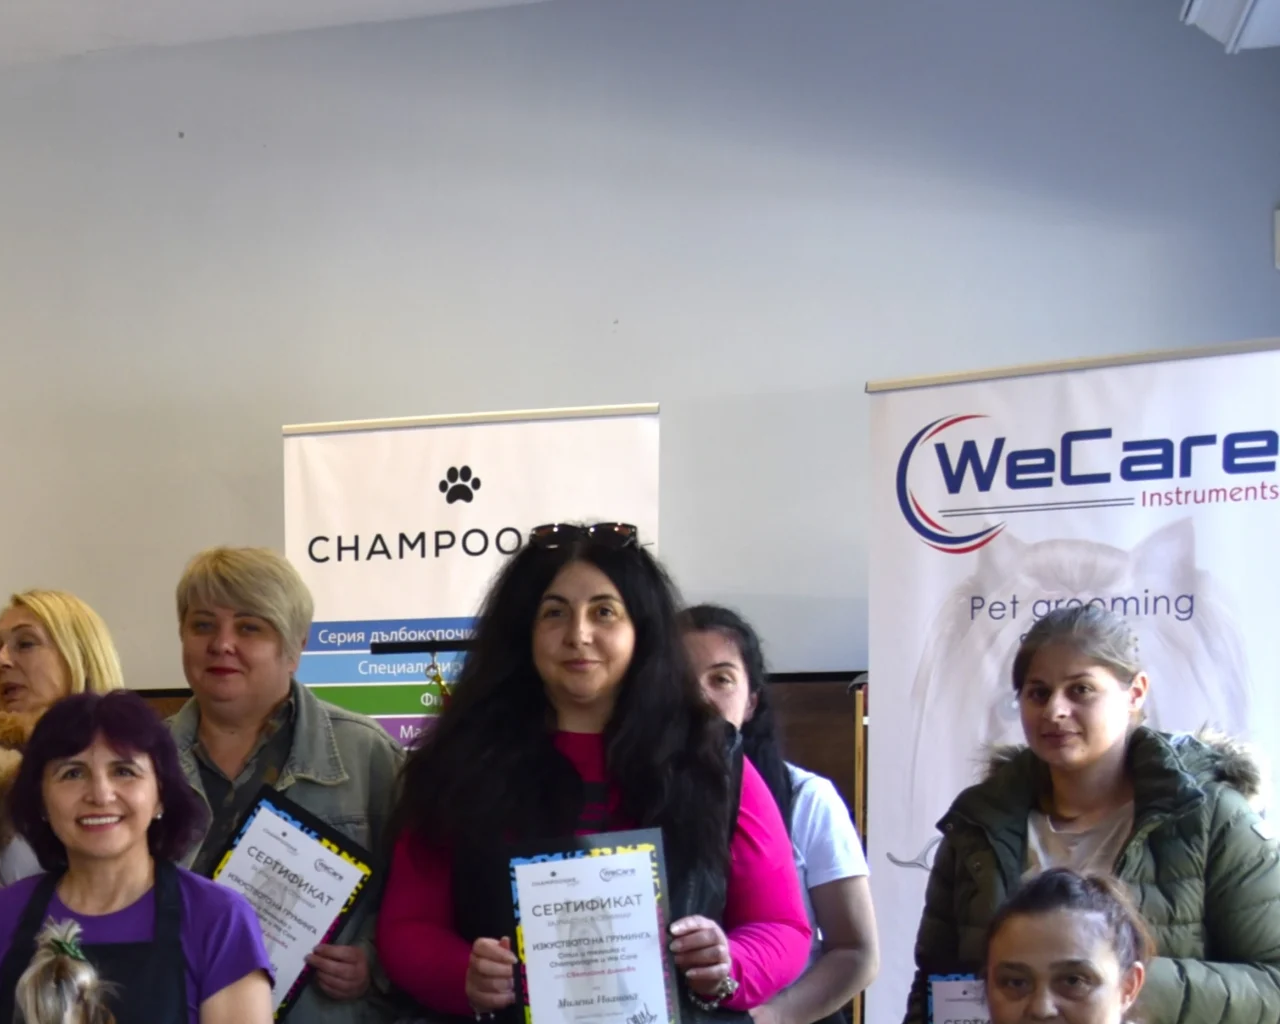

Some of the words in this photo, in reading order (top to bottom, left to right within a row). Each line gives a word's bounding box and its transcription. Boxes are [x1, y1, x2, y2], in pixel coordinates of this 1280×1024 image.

[934, 428, 1280, 494] WeCare
[1140, 481, 1279, 508] Instruments
[970, 594, 1019, 621] Pet
[318, 629, 365, 647] Серия
[370, 627, 478, 643] дълбокопочи
[247, 846, 335, 906] СЕРТИФИКАТ
[530, 894, 643, 916] СЕРТИФИКАТ
